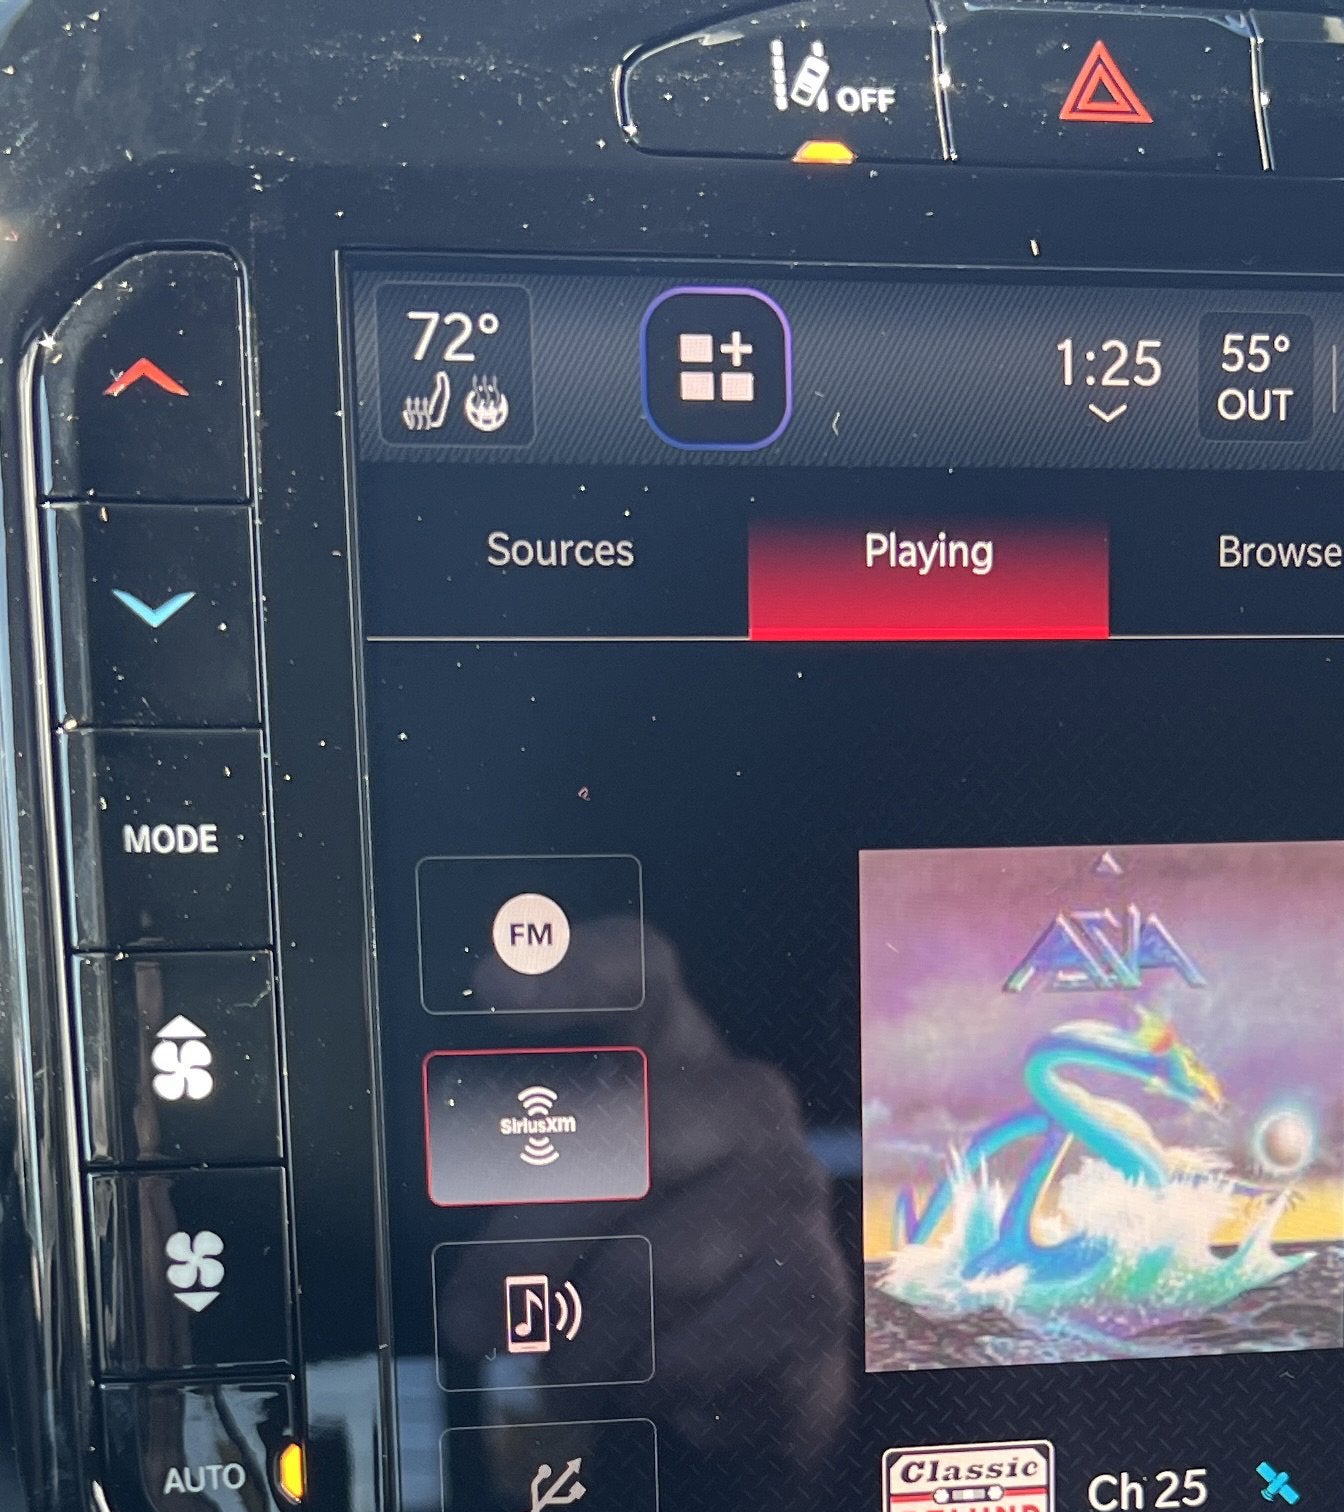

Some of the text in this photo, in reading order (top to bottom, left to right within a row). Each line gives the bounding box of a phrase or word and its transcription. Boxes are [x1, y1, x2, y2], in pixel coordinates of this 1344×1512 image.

[836, 87, 896, 114] OFF
[407, 311, 500, 362] 72°
[1220, 333, 1291, 373] 55°
[1056, 338, 1163, 388] 1:25
[1217, 388, 1294, 422] OUT
[486, 531, 635, 568] Sources
[865, 531, 994, 575] Playing
[1218, 535, 1344, 569] Browse
[123, 824, 220, 856] MODE
[508, 922, 554, 948] FM
[163, 1462, 247, 1495] AUTO
[899, 1456, 1040, 1486] Classic
[1087, 1468, 1208, 1512] Ch 25
